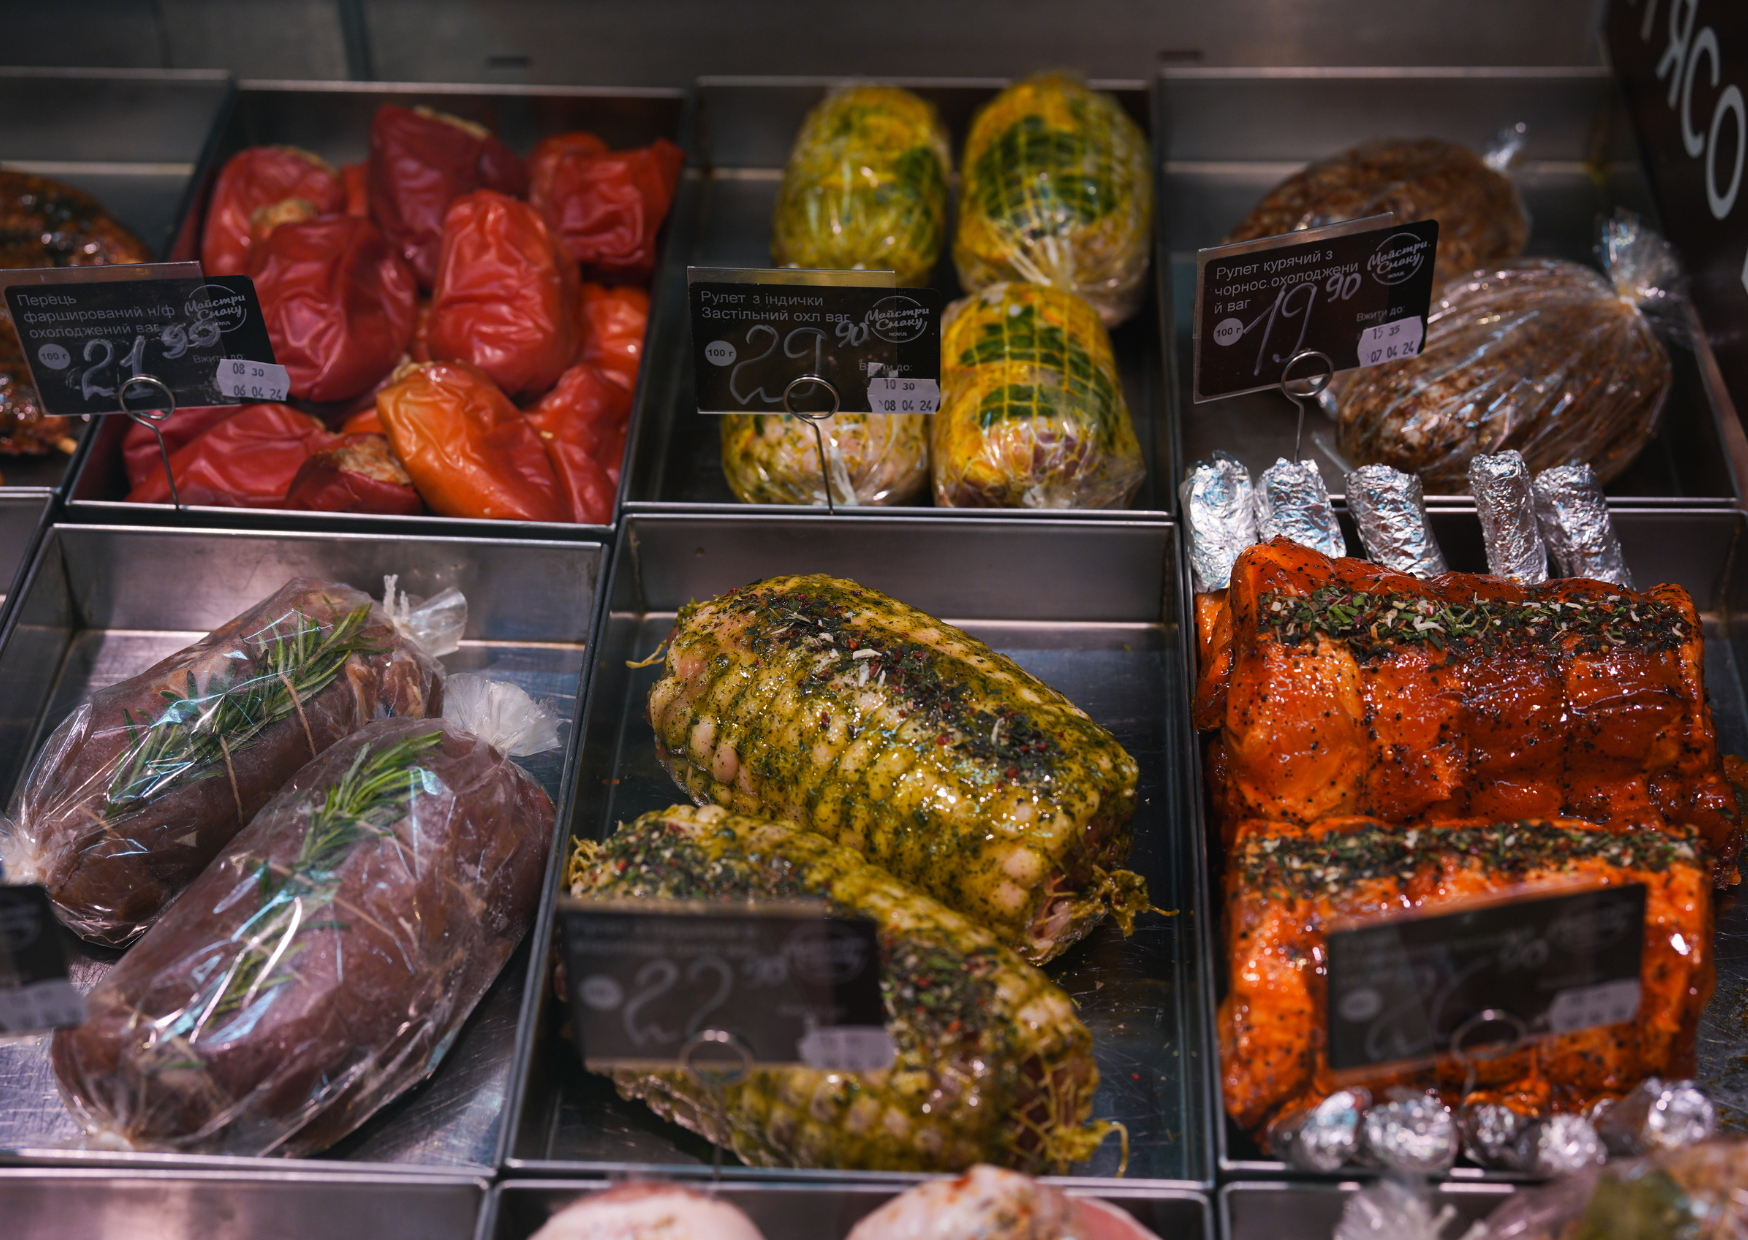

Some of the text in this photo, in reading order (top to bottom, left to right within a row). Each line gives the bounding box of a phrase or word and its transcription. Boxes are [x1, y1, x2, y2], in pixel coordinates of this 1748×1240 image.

[1627, 0, 1747, 220] ЯСО
[1367, 240, 1428, 271] Майстри
[1376, 252, 1421, 274] Смаку
[1216, 263, 1259, 281] Рулет
[1263, 249, 1321, 274] курячий
[1325, 272, 1362, 302] 90
[17, 294, 77, 308] Перець
[184, 294, 246, 316] Майстри
[700, 290, 746, 306] Рулет
[765, 293, 824, 307] індички
[197, 305, 242, 321] Смаку
[1214, 299, 1251, 314] й ваг
[23, 305, 175, 324] фарширований н/ф
[701, 306, 851, 323] Застільний охл ваг
[864, 308, 930, 325] Майстри
[1356, 309, 1388, 322] Вжити
[29, 323, 132, 338] охолоджений
[875, 317, 923, 331] Смаку
[1216, 326, 1241, 337] 100 г
[1388, 324, 1400, 336] 35
[835, 320, 869, 348] 90
[41, 352, 59, 361] 100
[708, 349, 726, 357] 100
[1370, 341, 1415, 363] 07 04 24
[82, 335, 154, 401] 21
[232, 362, 264, 377] 08 30
[897, 364, 913, 373] до:
[884, 378, 915, 391] 10 30
[233, 385, 283, 400] 06 04 24
[884, 400, 932, 412] 08 04 24
